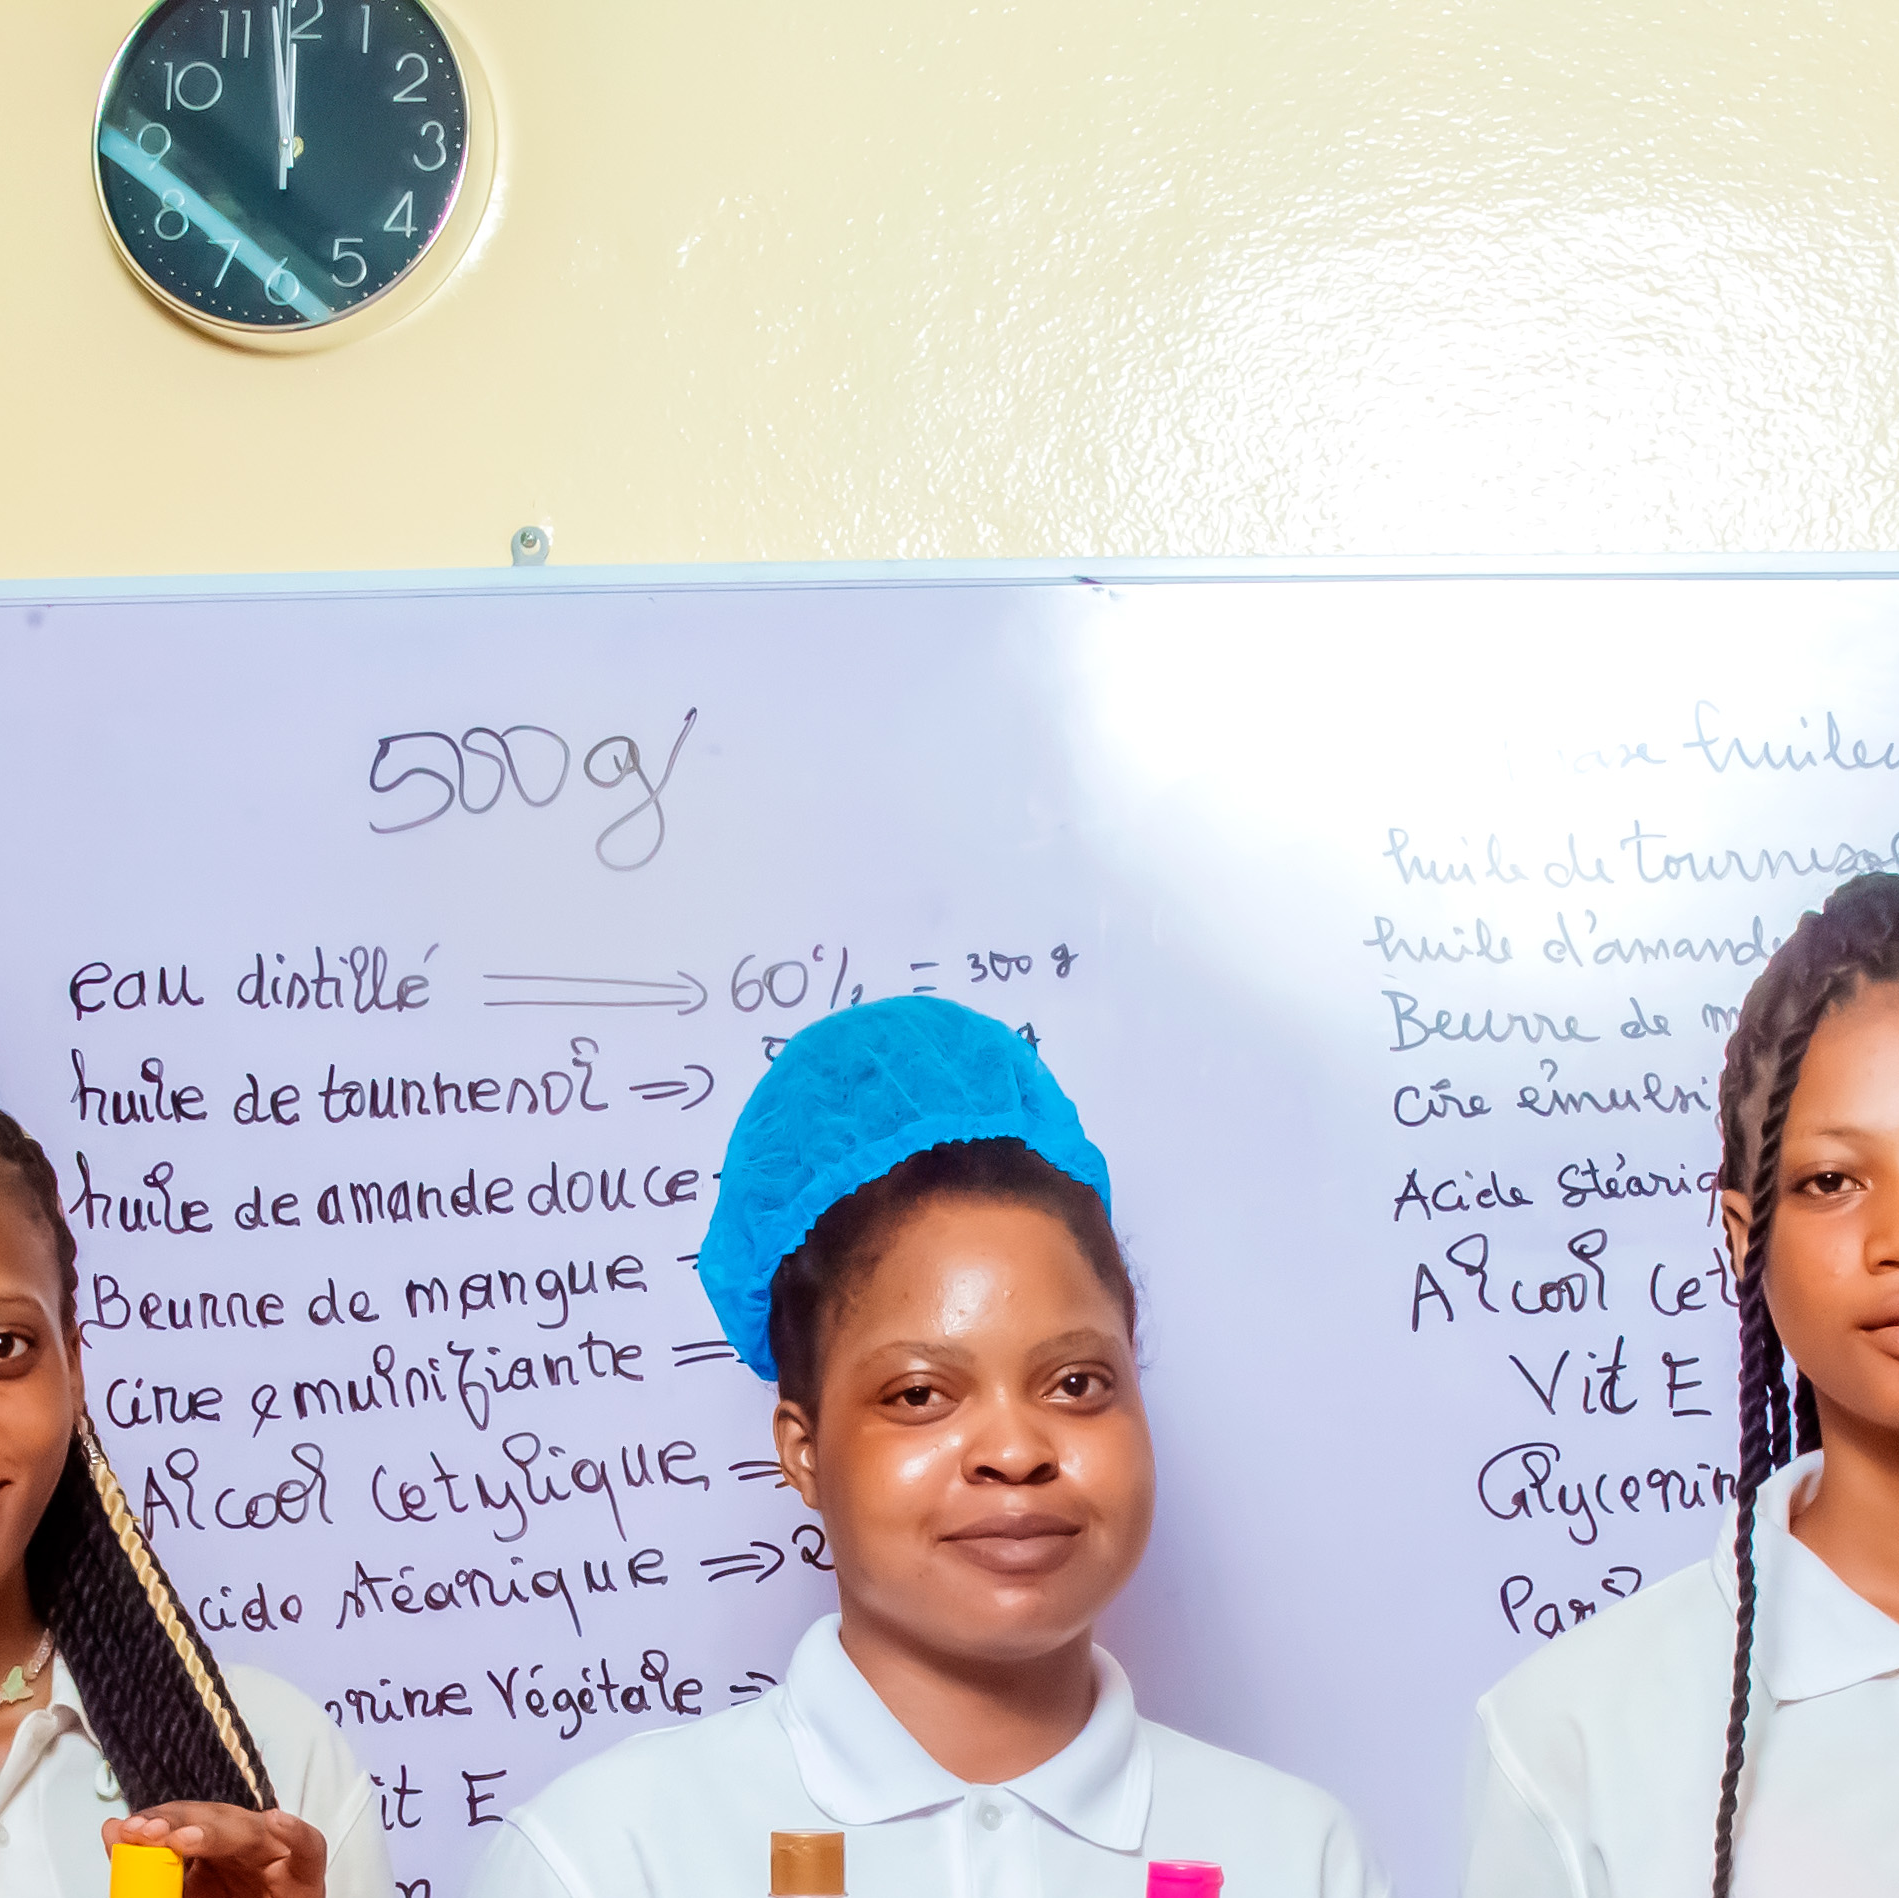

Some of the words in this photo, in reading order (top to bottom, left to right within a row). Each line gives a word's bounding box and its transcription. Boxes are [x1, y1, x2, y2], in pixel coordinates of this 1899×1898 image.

[219, 9, 252, 59] 11
[360, 4, 371, 54] 1
[164, 61, 224, 111] 10
[392, 52, 429, 103] 2
[137, 122, 172, 171] 9
[412, 120, 447, 172] 3
[154, 188, 190, 241] 8
[383, 190, 418, 238] 4
[207, 238, 240, 289] 7
[264, 257, 300, 306] 6
[331, 237, 369, 288] 5
[1383, 827, 1530, 886] huile
[1543, 833, 1616, 888] de
[1362, 915, 1513, 964] huile
[69, 961, 205, 1021] eau
[237, 942, 441, 1014] distillé
[1380, 990, 1602, 1052] Beurre
[1619, 997, 1673, 1040] de
[69, 1048, 208, 1126] huile
[232, 1073, 301, 1126] de
[318, 1035, 610, 1124] tournesol
[1516, 1057, 1714, 1117] émulsi
[67, 1150, 214, 1235] huile
[234, 1186, 301, 1232] de
[315, 1167, 516, 1226] amande
[527, 1161, 703, 1217] douce
[1393, 1168, 1535, 1222] Acide
[1557, 1151, 1724, 1228] Stéariq
[79, 1273, 285, 1349] Beurre
[307, 1277, 382, 1327] de
[405, 1254, 648, 1330] mangue
[1410, 1228, 1610, 1333] Alcool
[1508, 1334, 1639, 1416] Vit
[1661, 1350, 1713, 1418] E
[143, 1442, 335, 1542] Alcool
[1477, 1441, 1739, 1546] Glycerin
[461, 1769, 508, 1828] E
